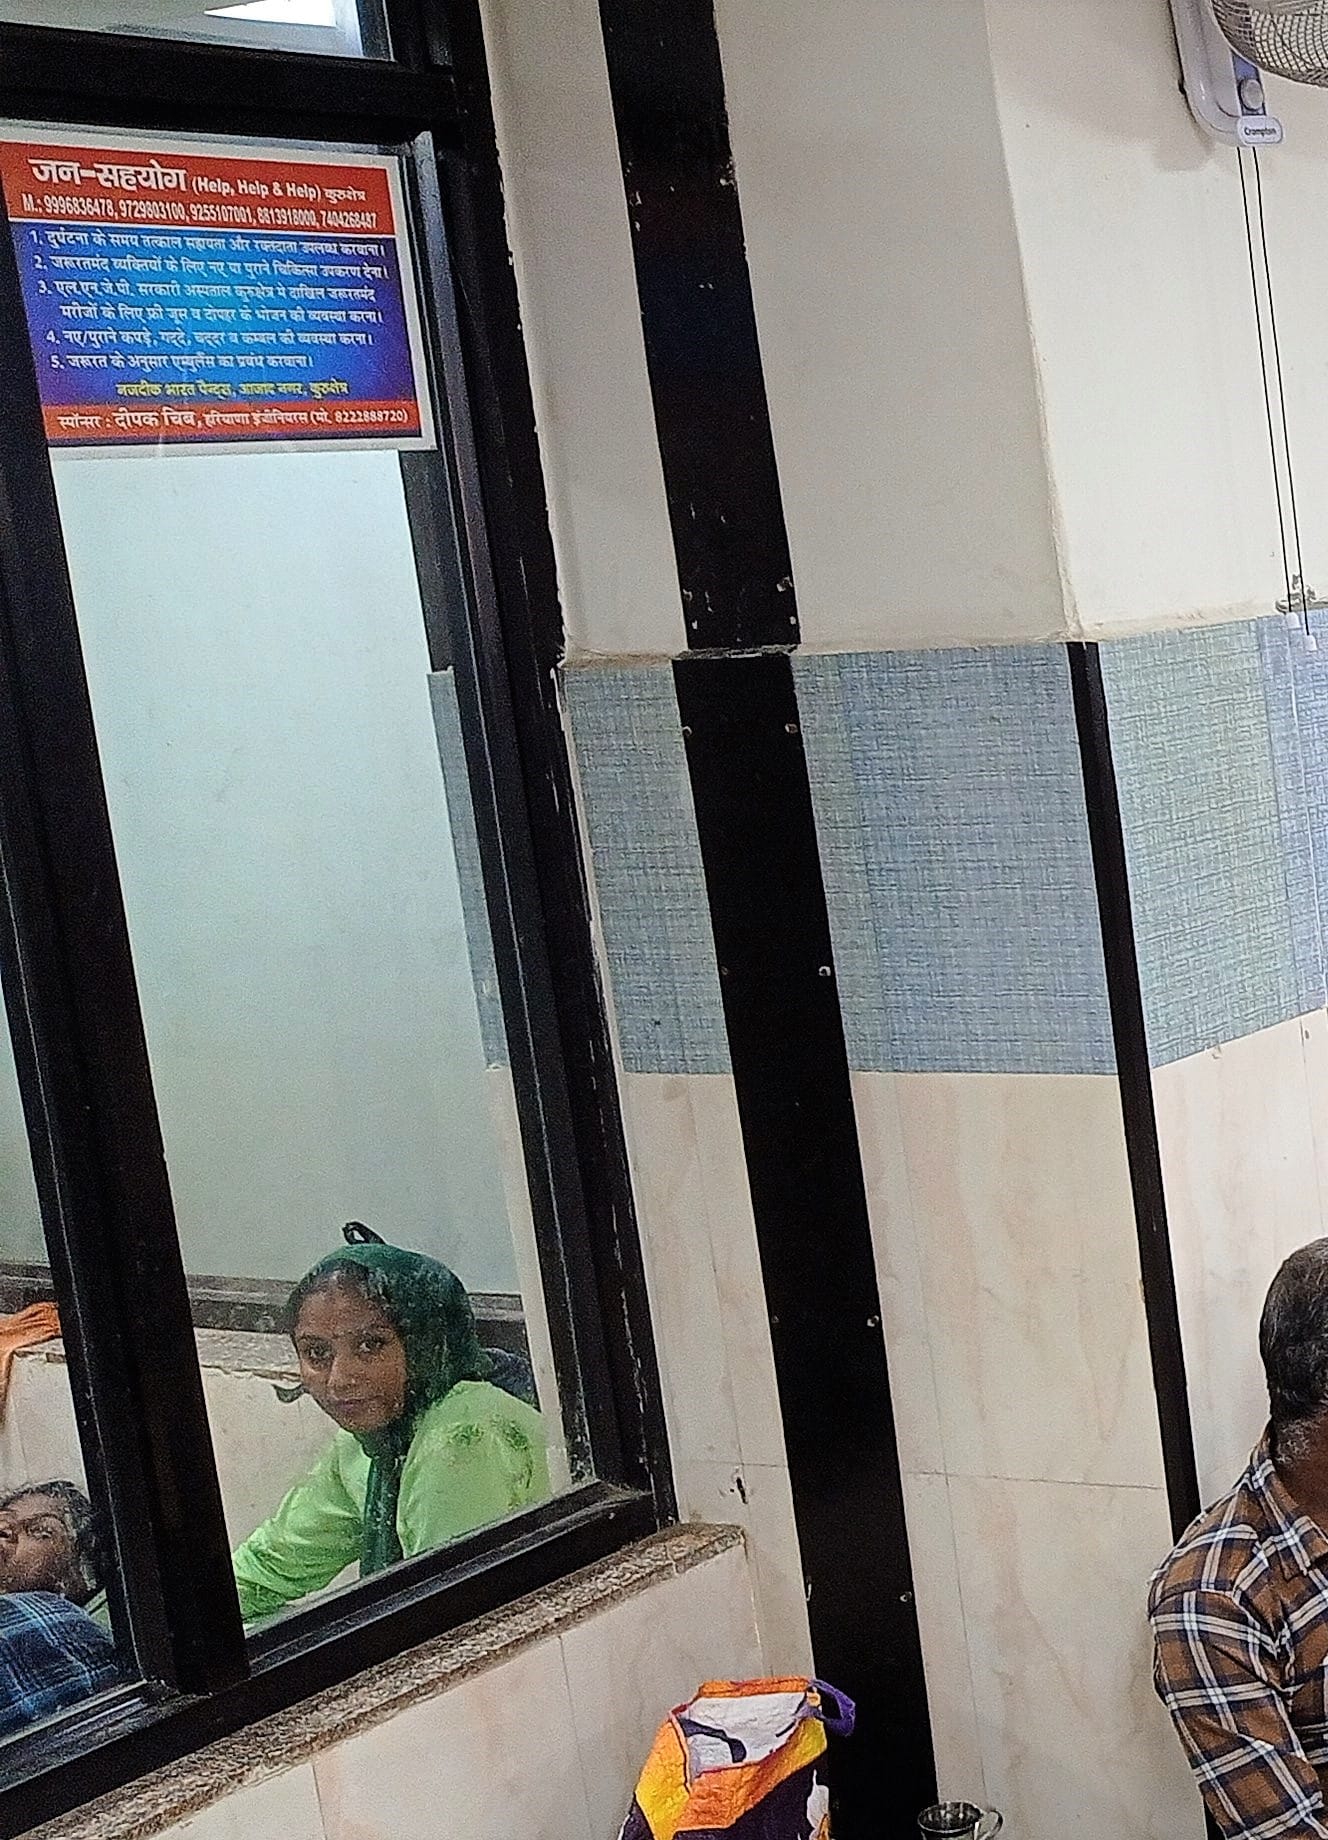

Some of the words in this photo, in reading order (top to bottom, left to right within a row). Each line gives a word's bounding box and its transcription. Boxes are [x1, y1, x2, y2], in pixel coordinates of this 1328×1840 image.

[27, 158, 187, 192] जन-सहयोग
[237, 179, 269, 198] Help
[273, 182, 282, 194] &
[286, 183, 321, 200] Help)
[112, 407, 159, 430] दीपक
